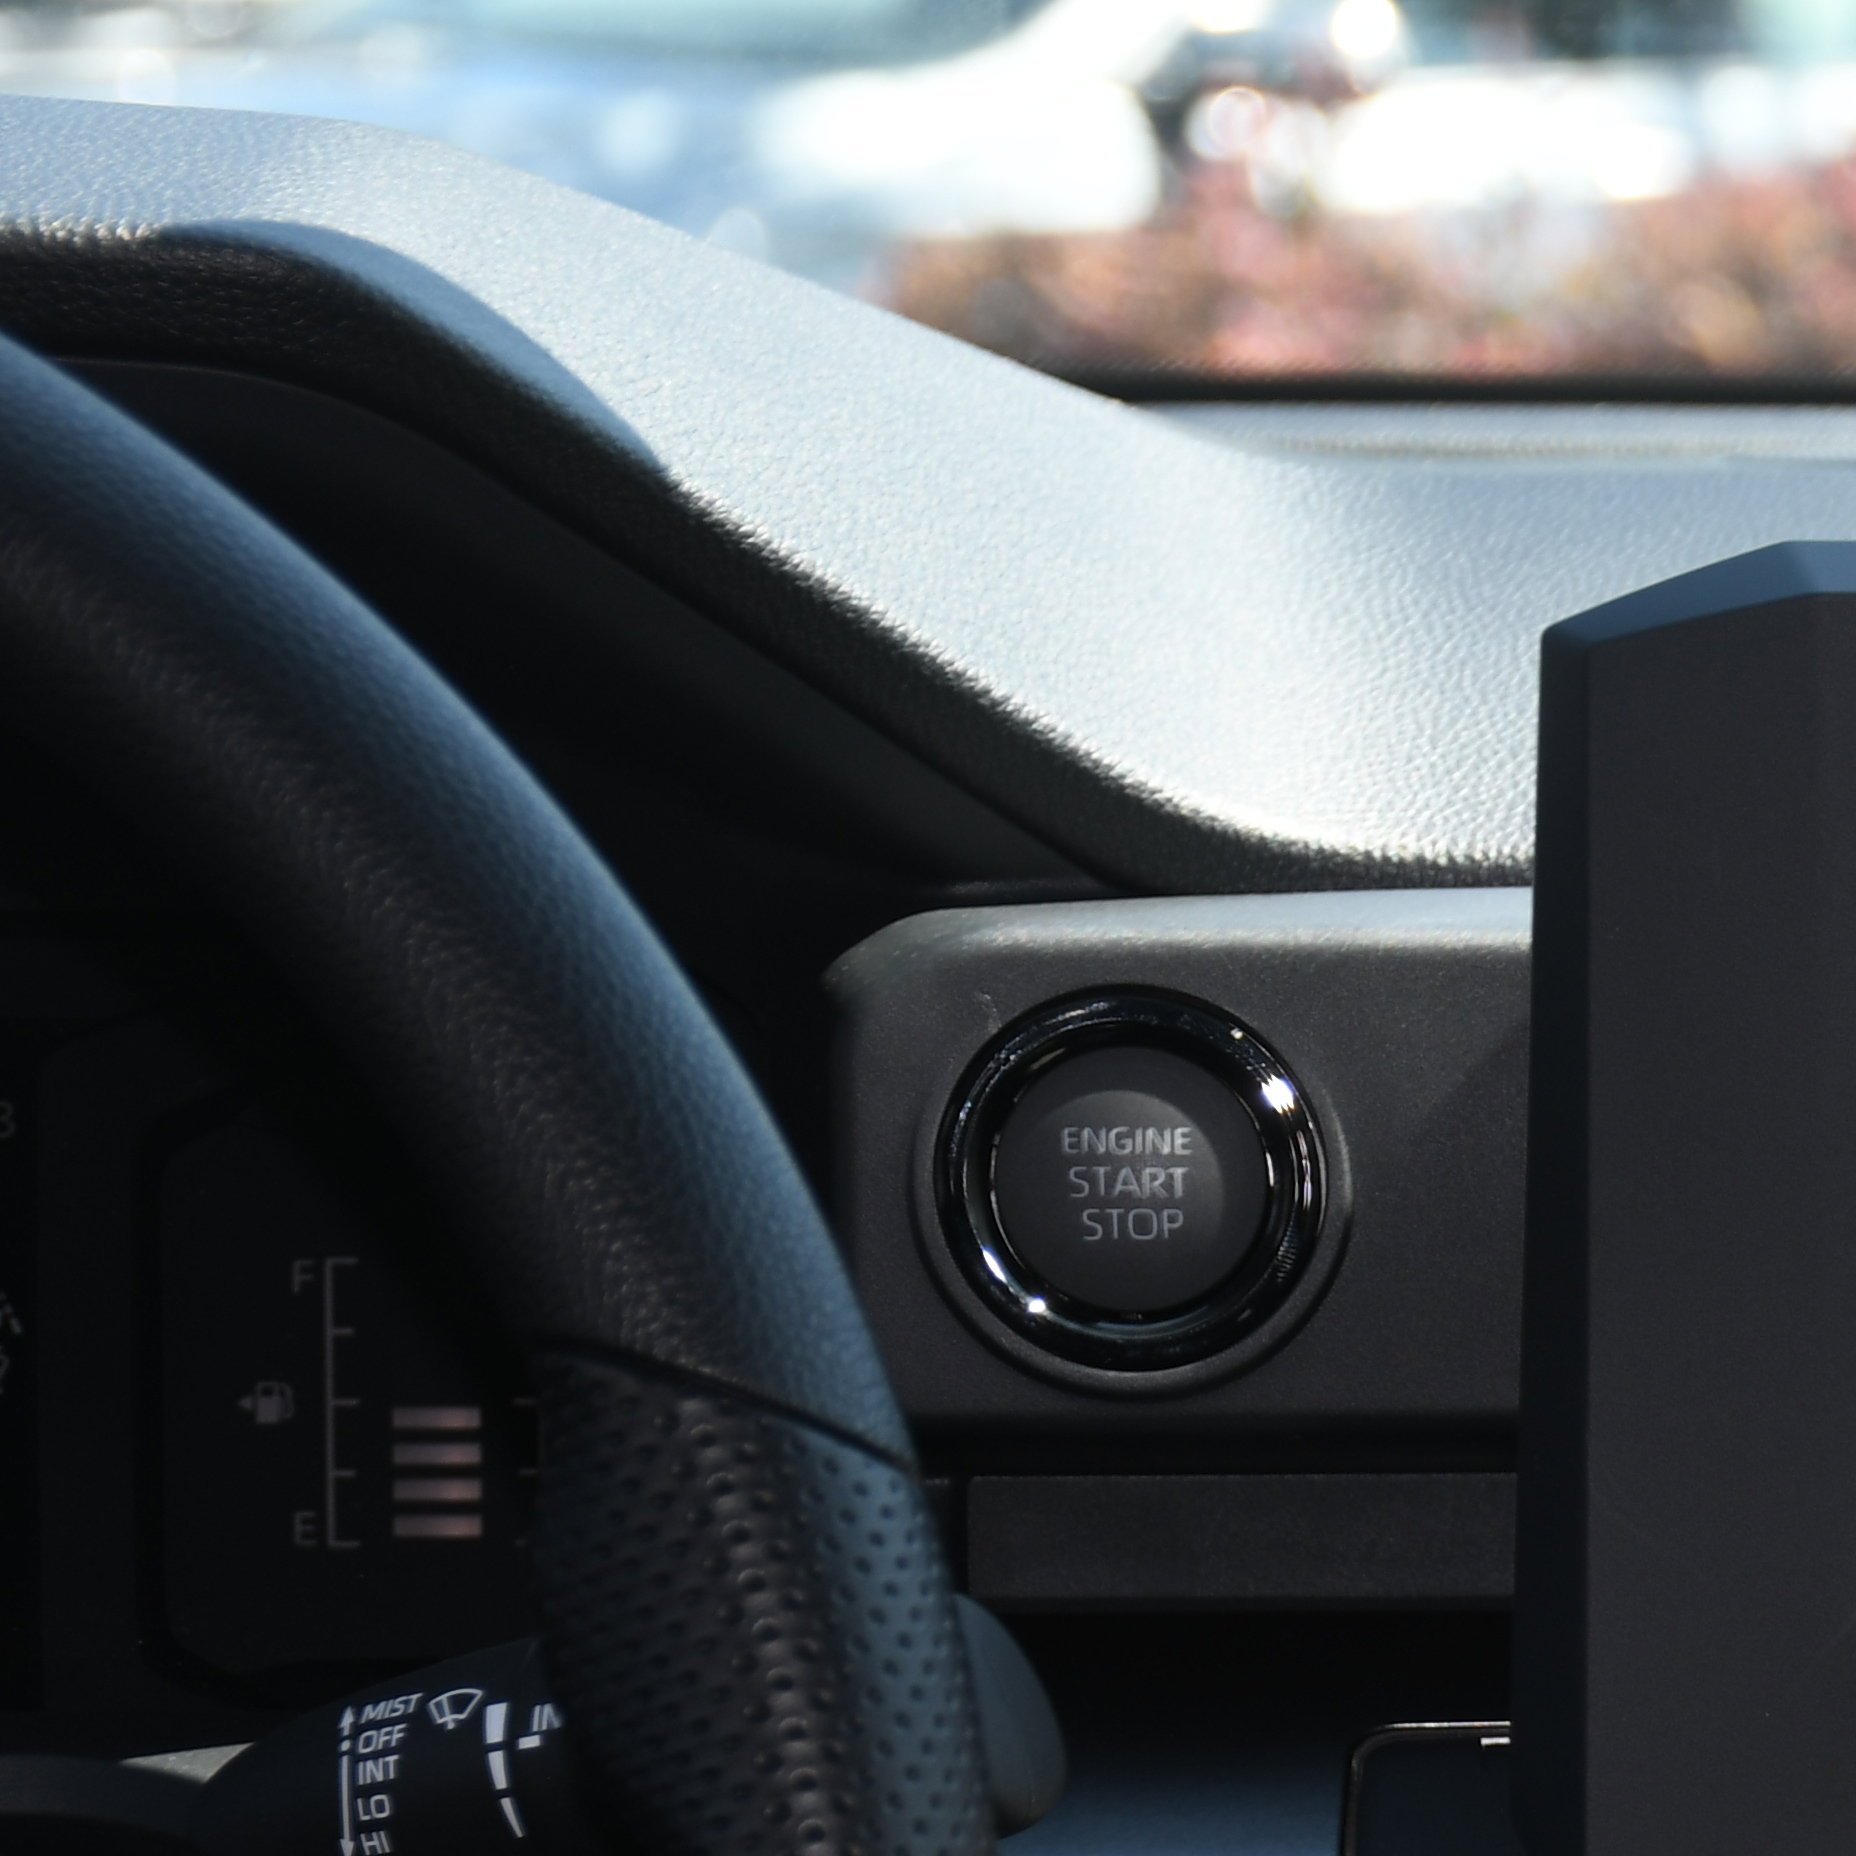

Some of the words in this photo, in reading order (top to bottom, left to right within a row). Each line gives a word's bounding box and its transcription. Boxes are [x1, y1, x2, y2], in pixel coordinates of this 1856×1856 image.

[1061, 1126, 1192, 1156] ENGINE
[1069, 1167, 1189, 1199] START
[1082, 1208, 1183, 1240] STOP
[291, 1259, 315, 1294] F
[293, 1510, 318, 1546] E
[359, 1692, 425, 1725] MIST
[358, 1723, 409, 1754] OFF
[357, 1754, 401, 1786] INT
[357, 1794, 391, 1821] LO
[360, 1830, 391, 1856] HI
